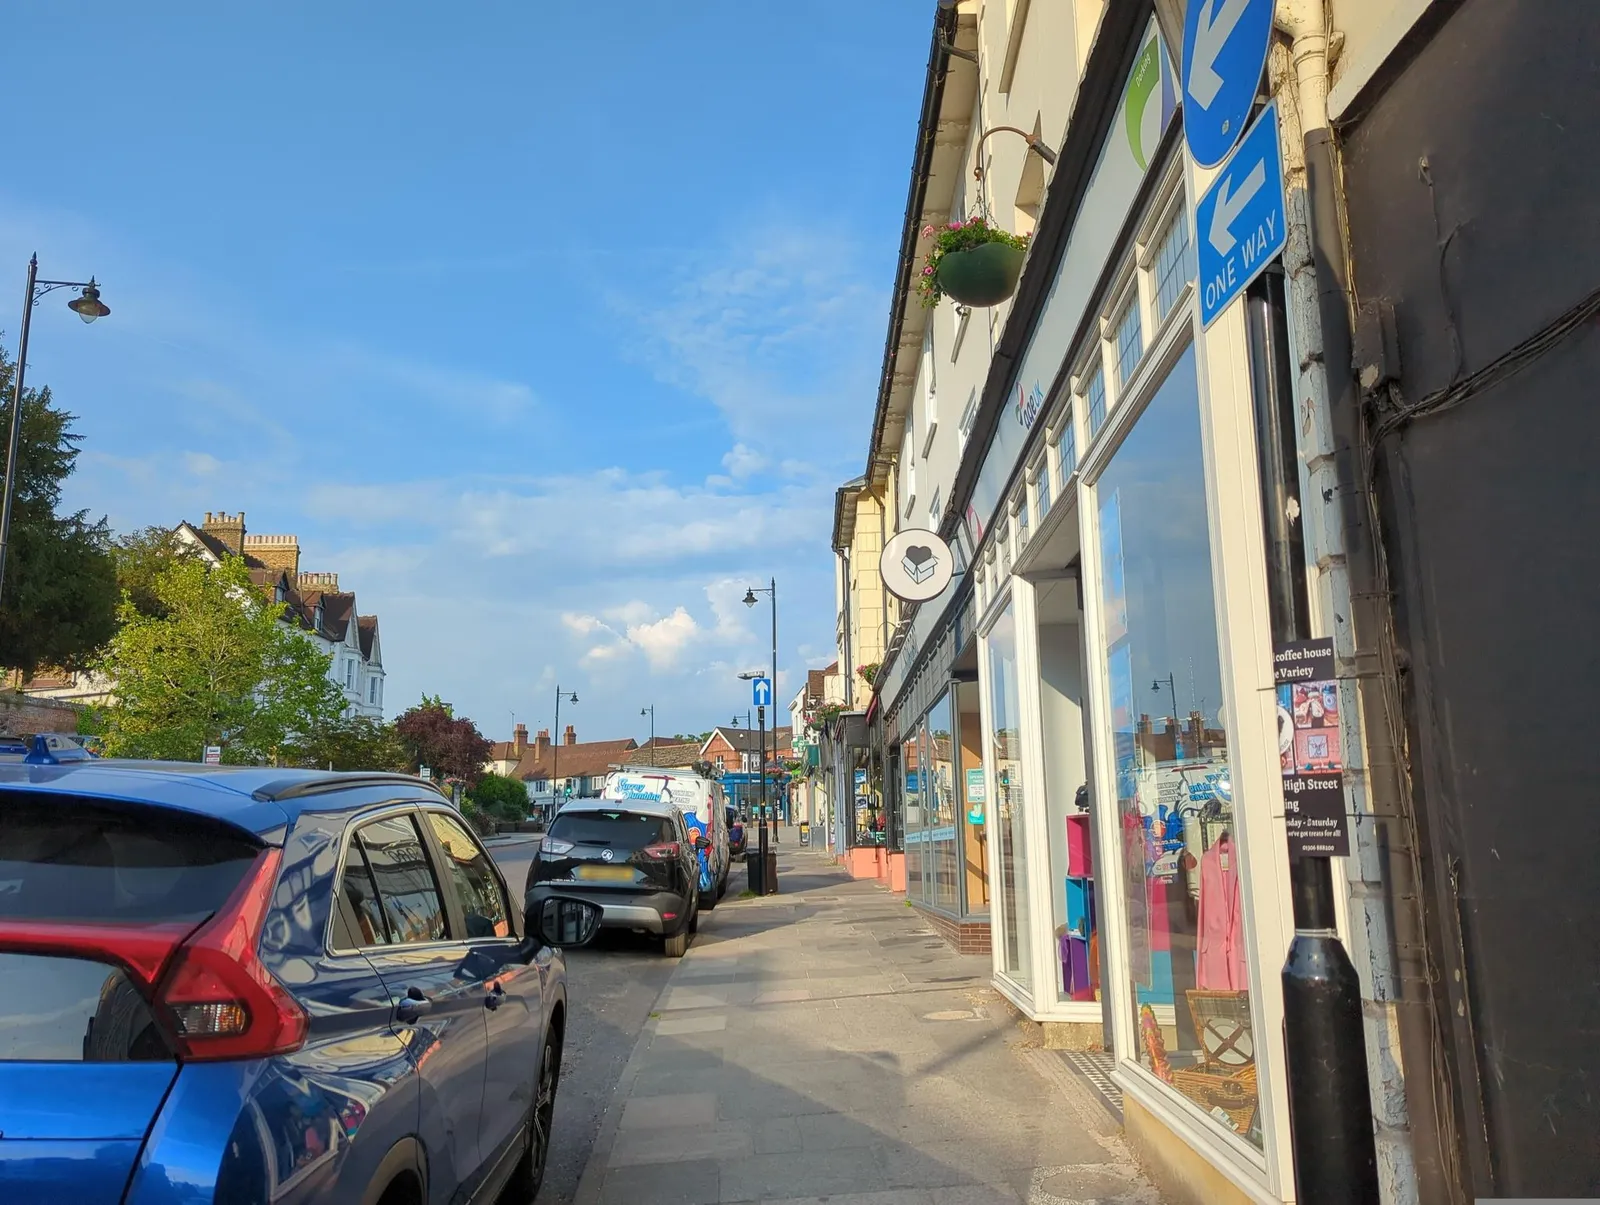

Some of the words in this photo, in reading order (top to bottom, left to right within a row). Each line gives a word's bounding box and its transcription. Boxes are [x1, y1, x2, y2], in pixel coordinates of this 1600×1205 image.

[1135, 52, 1151, 87] Dorking
[1205, 256, 1237, 310] ONE
[1242, 209, 1276, 269] WAY
[1276, 650, 1302, 662] coffee
[1303, 648, 1331, 659] house
[1280, 666, 1314, 678] Variety
[615, 777, 645, 793] Surrey
[1284, 778, 1305, 793] High
[1307, 779, 1338, 790] Street
[622, 790, 662, 802] Plumbing
[1284, 798, 1299, 813] ing
[1324, 829, 1332, 837] for
